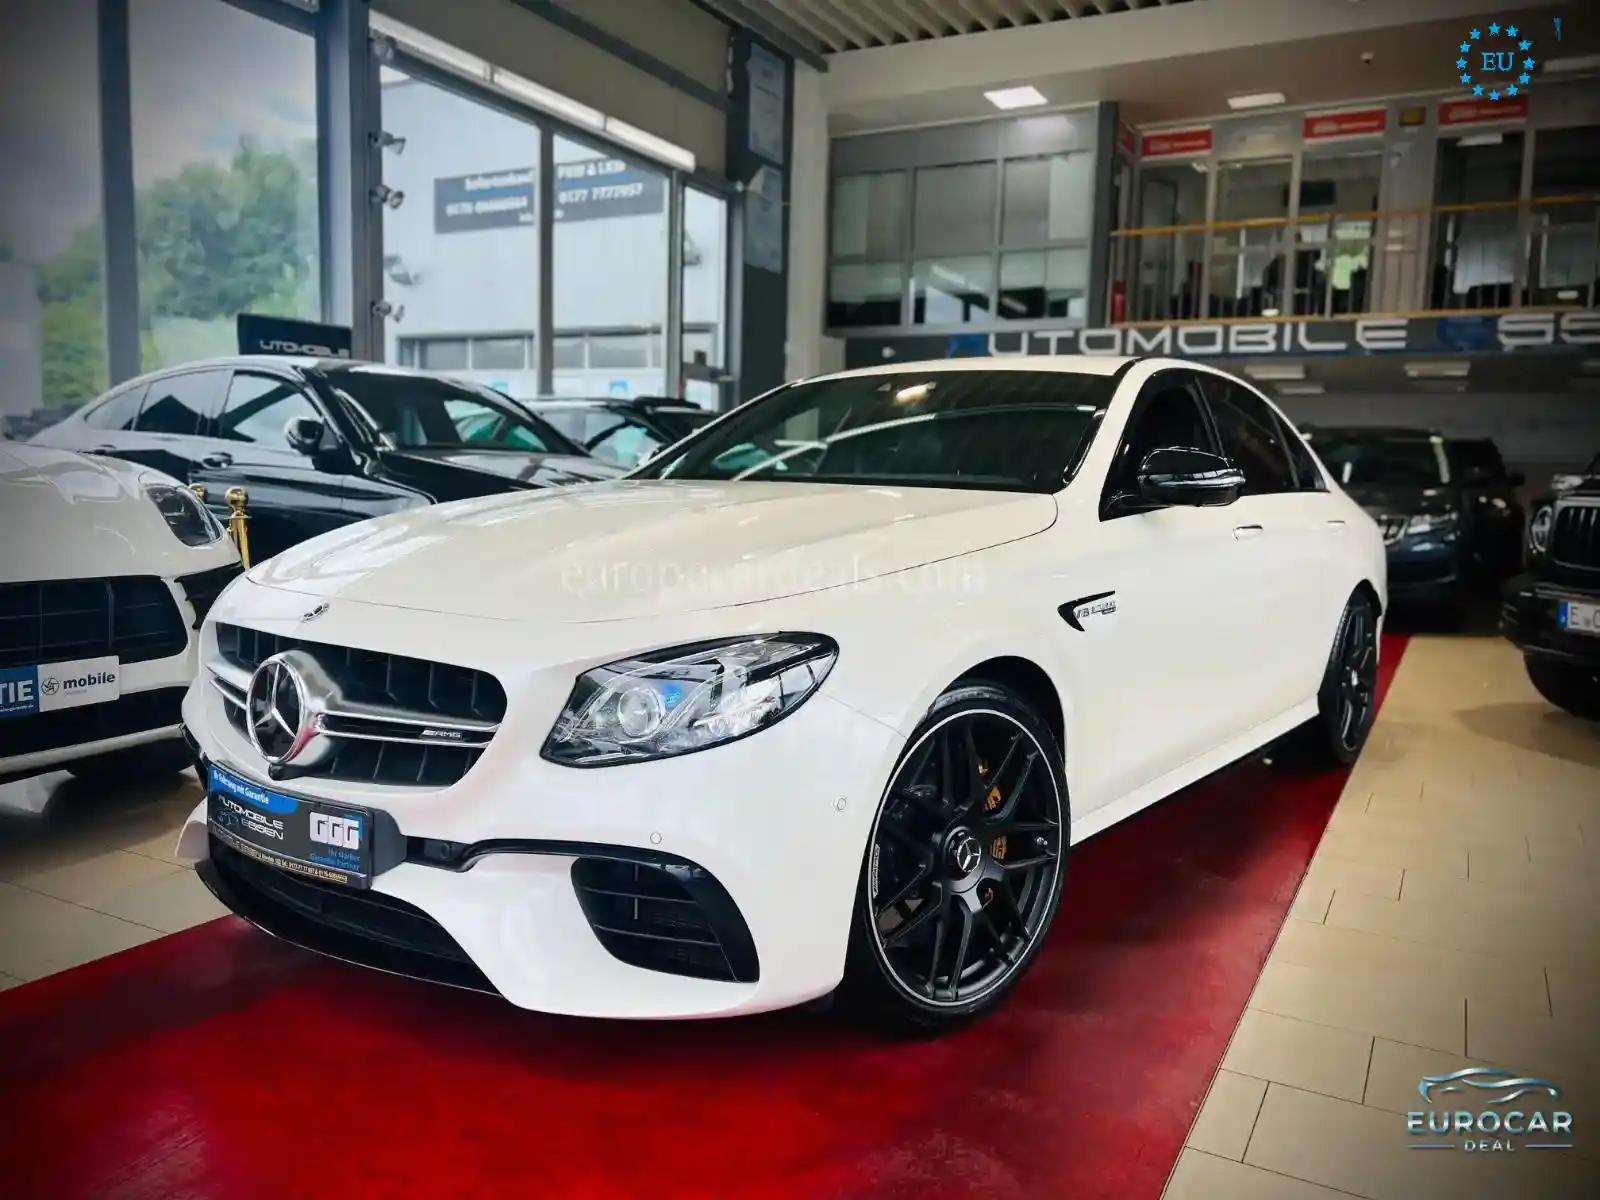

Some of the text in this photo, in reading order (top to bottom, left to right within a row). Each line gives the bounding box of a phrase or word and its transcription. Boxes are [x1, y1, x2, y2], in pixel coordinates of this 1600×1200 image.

[63, 672, 115, 689] mobile
[218, 794, 284, 830] AUTOMOBILE
[241, 816, 284, 841] ESSEN
[310, 811, 360, 850] GGG
